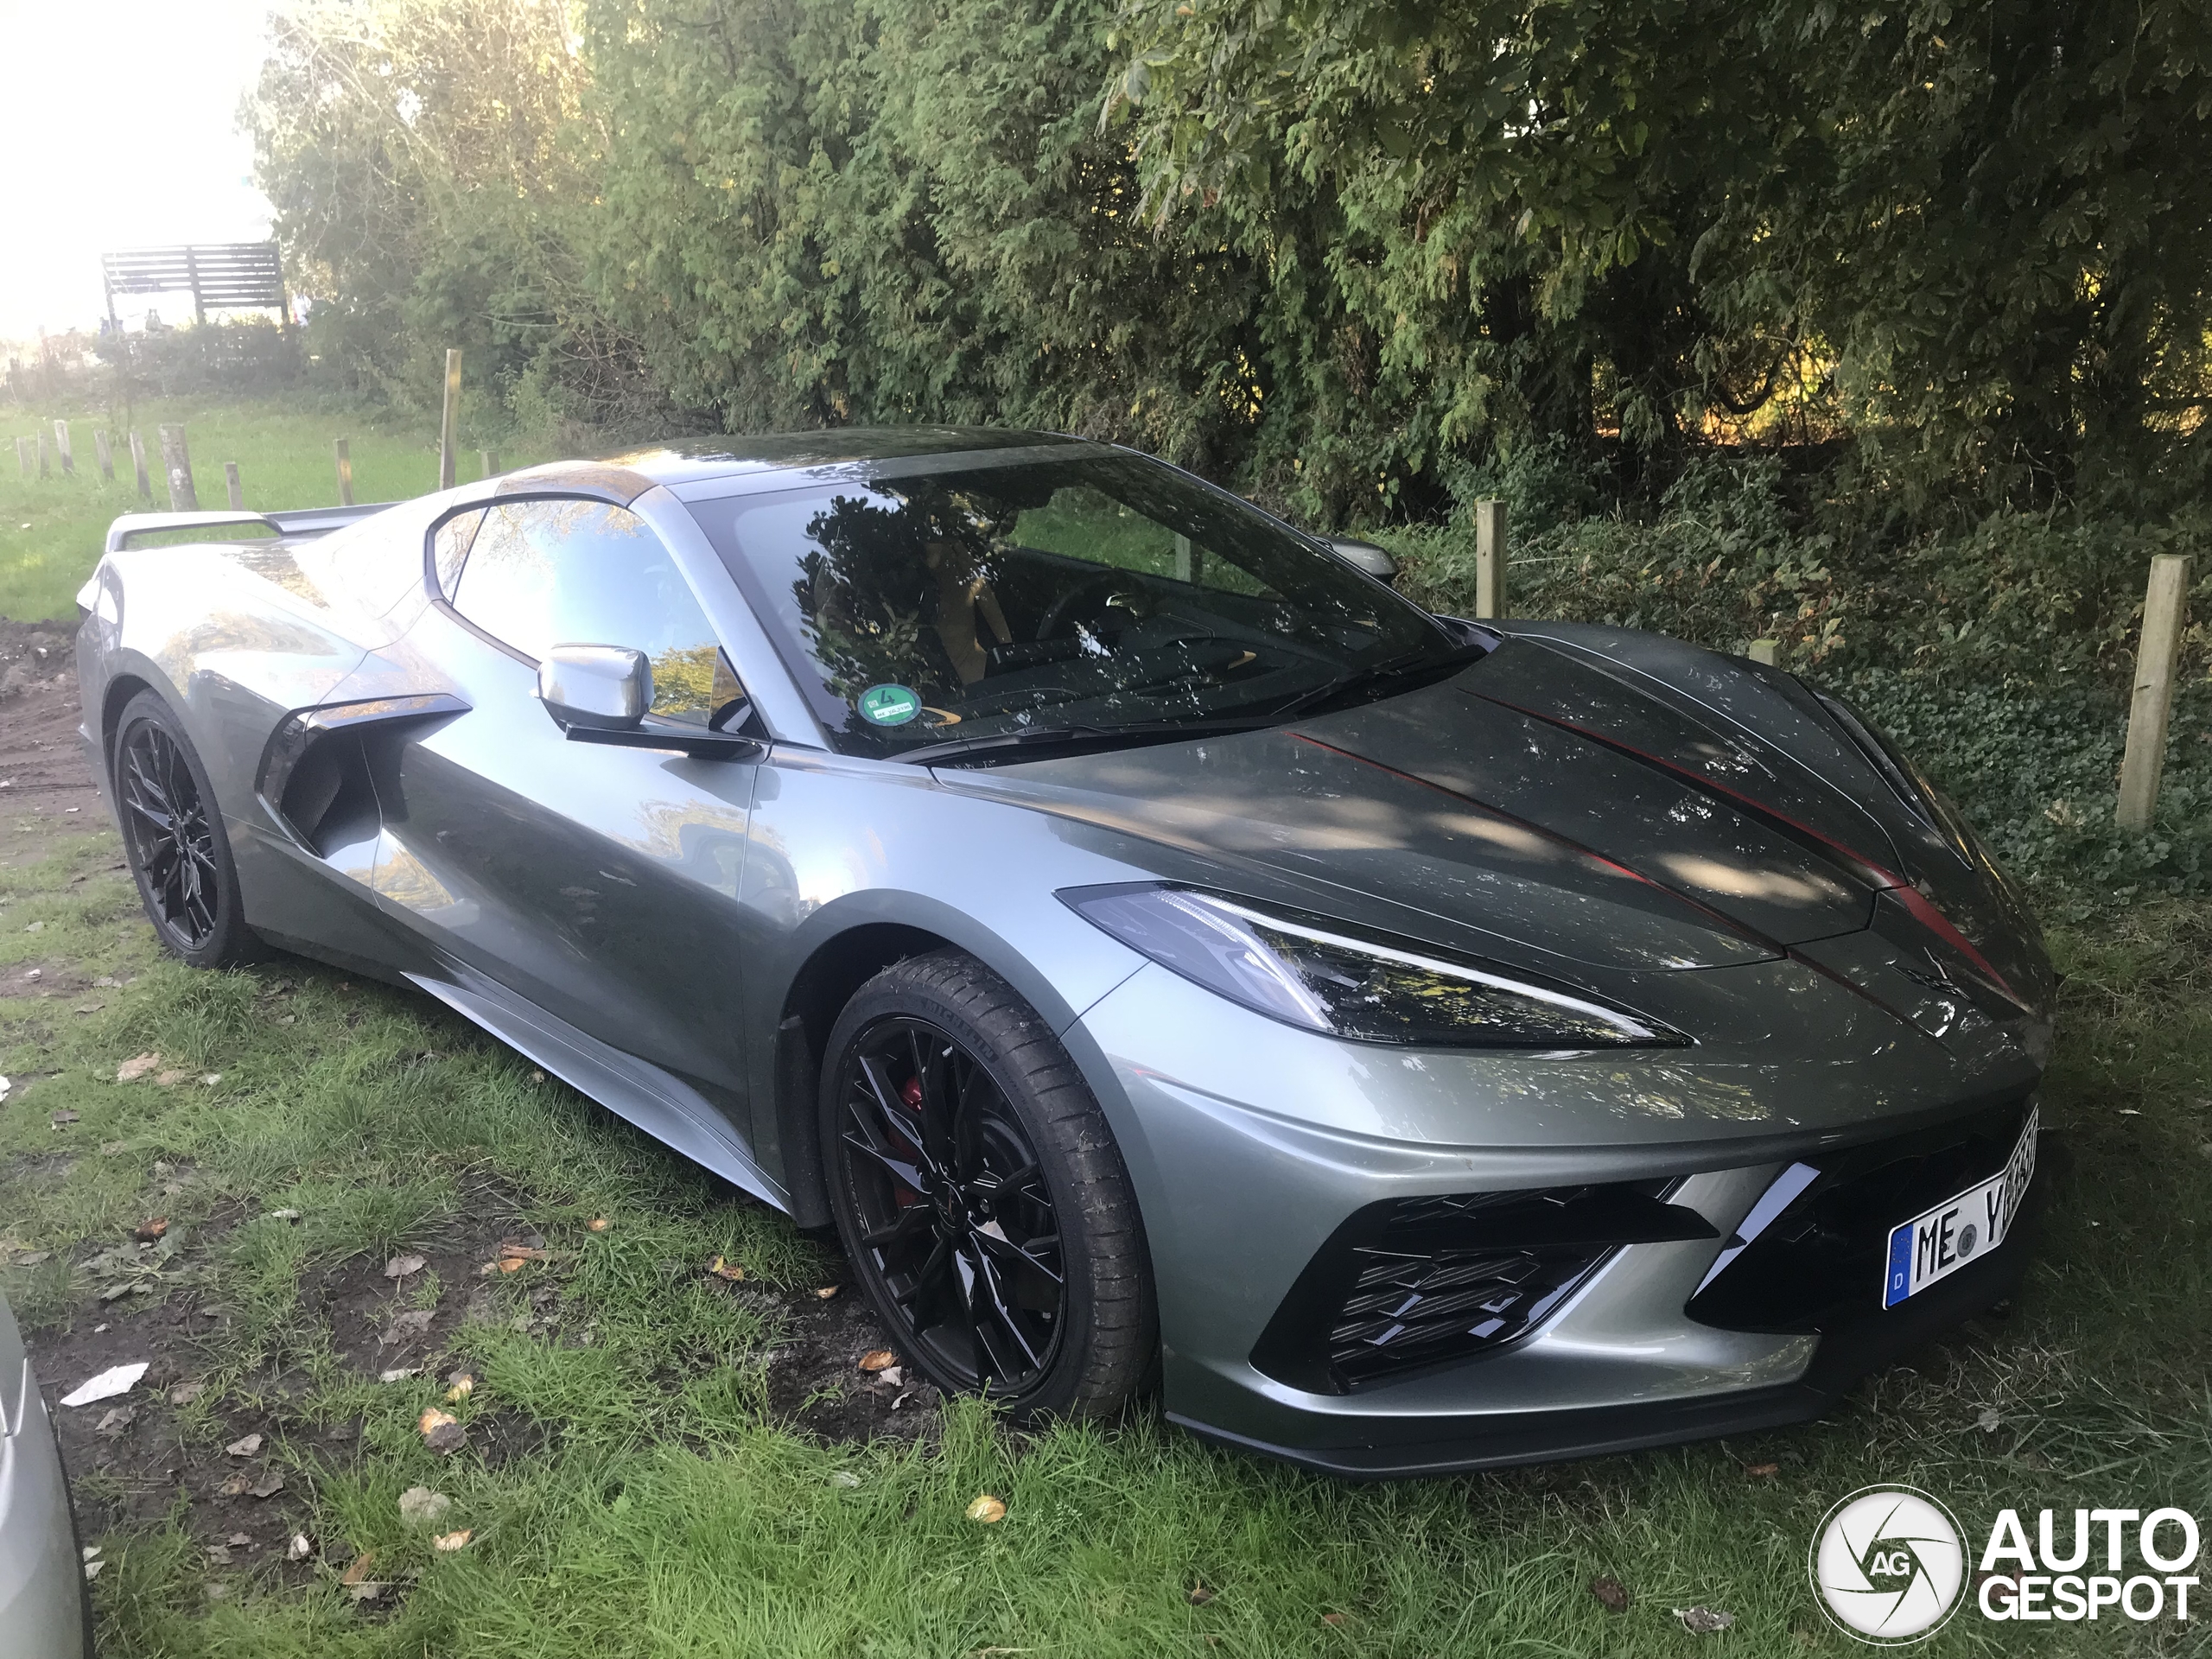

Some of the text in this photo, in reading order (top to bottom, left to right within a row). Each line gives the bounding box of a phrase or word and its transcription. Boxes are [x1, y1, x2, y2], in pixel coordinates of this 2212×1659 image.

[880, 690, 895, 704] 4
[925, 998, 996, 1061] MICHELIN
[1916, 1207, 1959, 1283] ME
[1893, 1272, 1904, 1291] D
